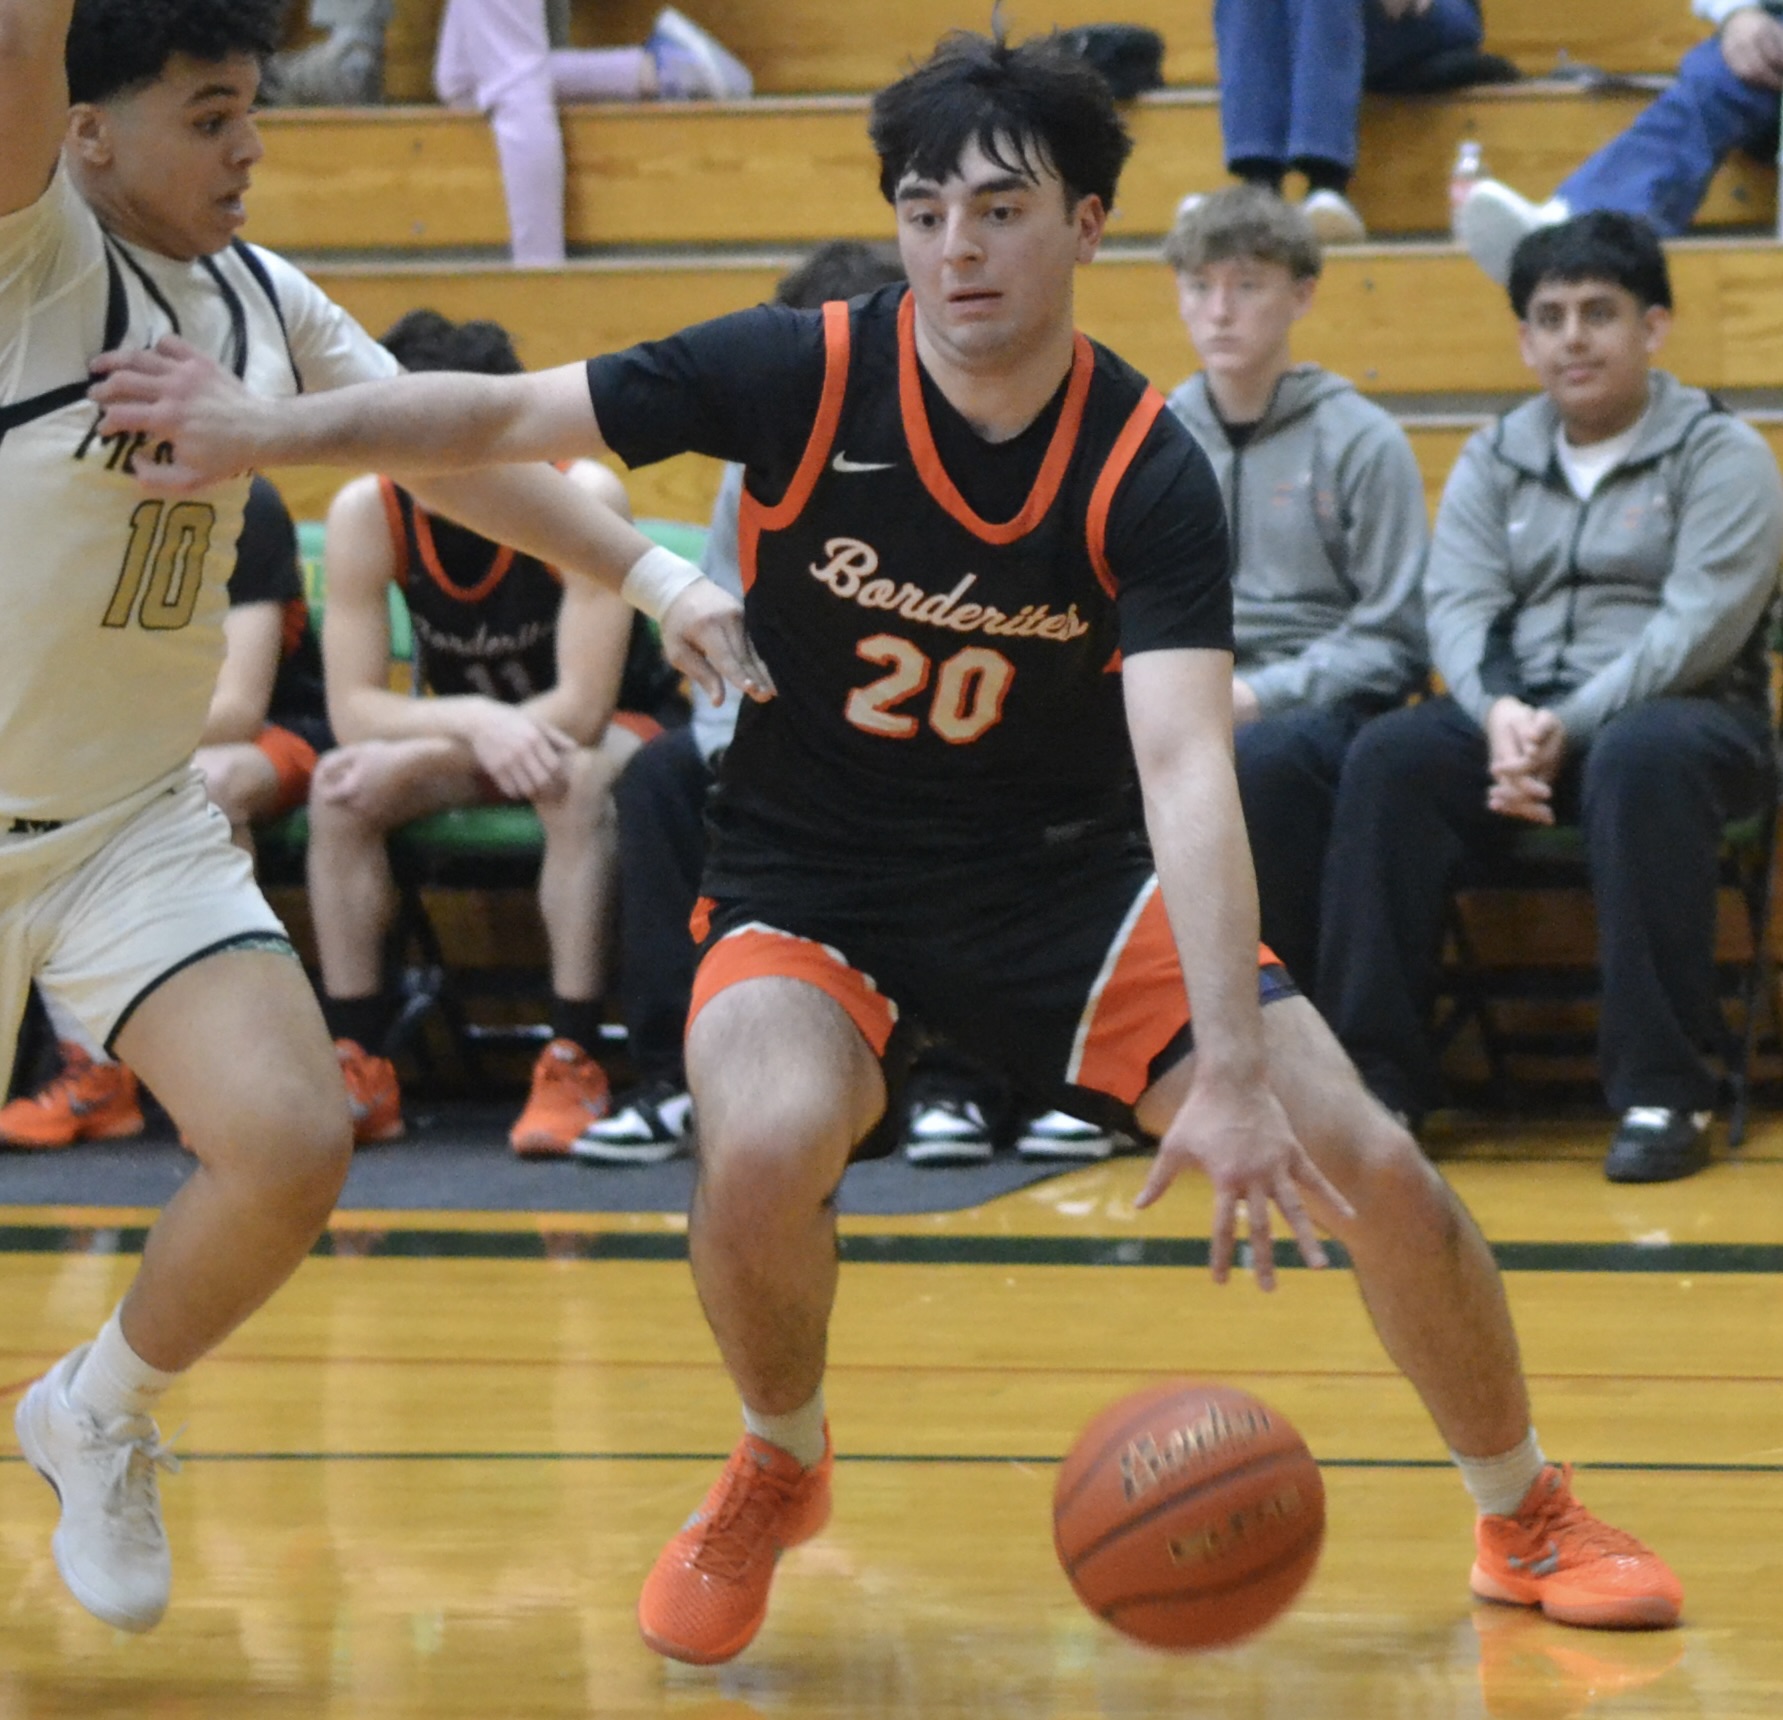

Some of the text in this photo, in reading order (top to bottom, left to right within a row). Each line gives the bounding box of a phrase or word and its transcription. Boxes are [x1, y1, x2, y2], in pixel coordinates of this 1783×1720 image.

[101, 499, 214, 629] 10
[809, 537, 1089, 641] Borderites
[844, 633, 1016, 744] 20
